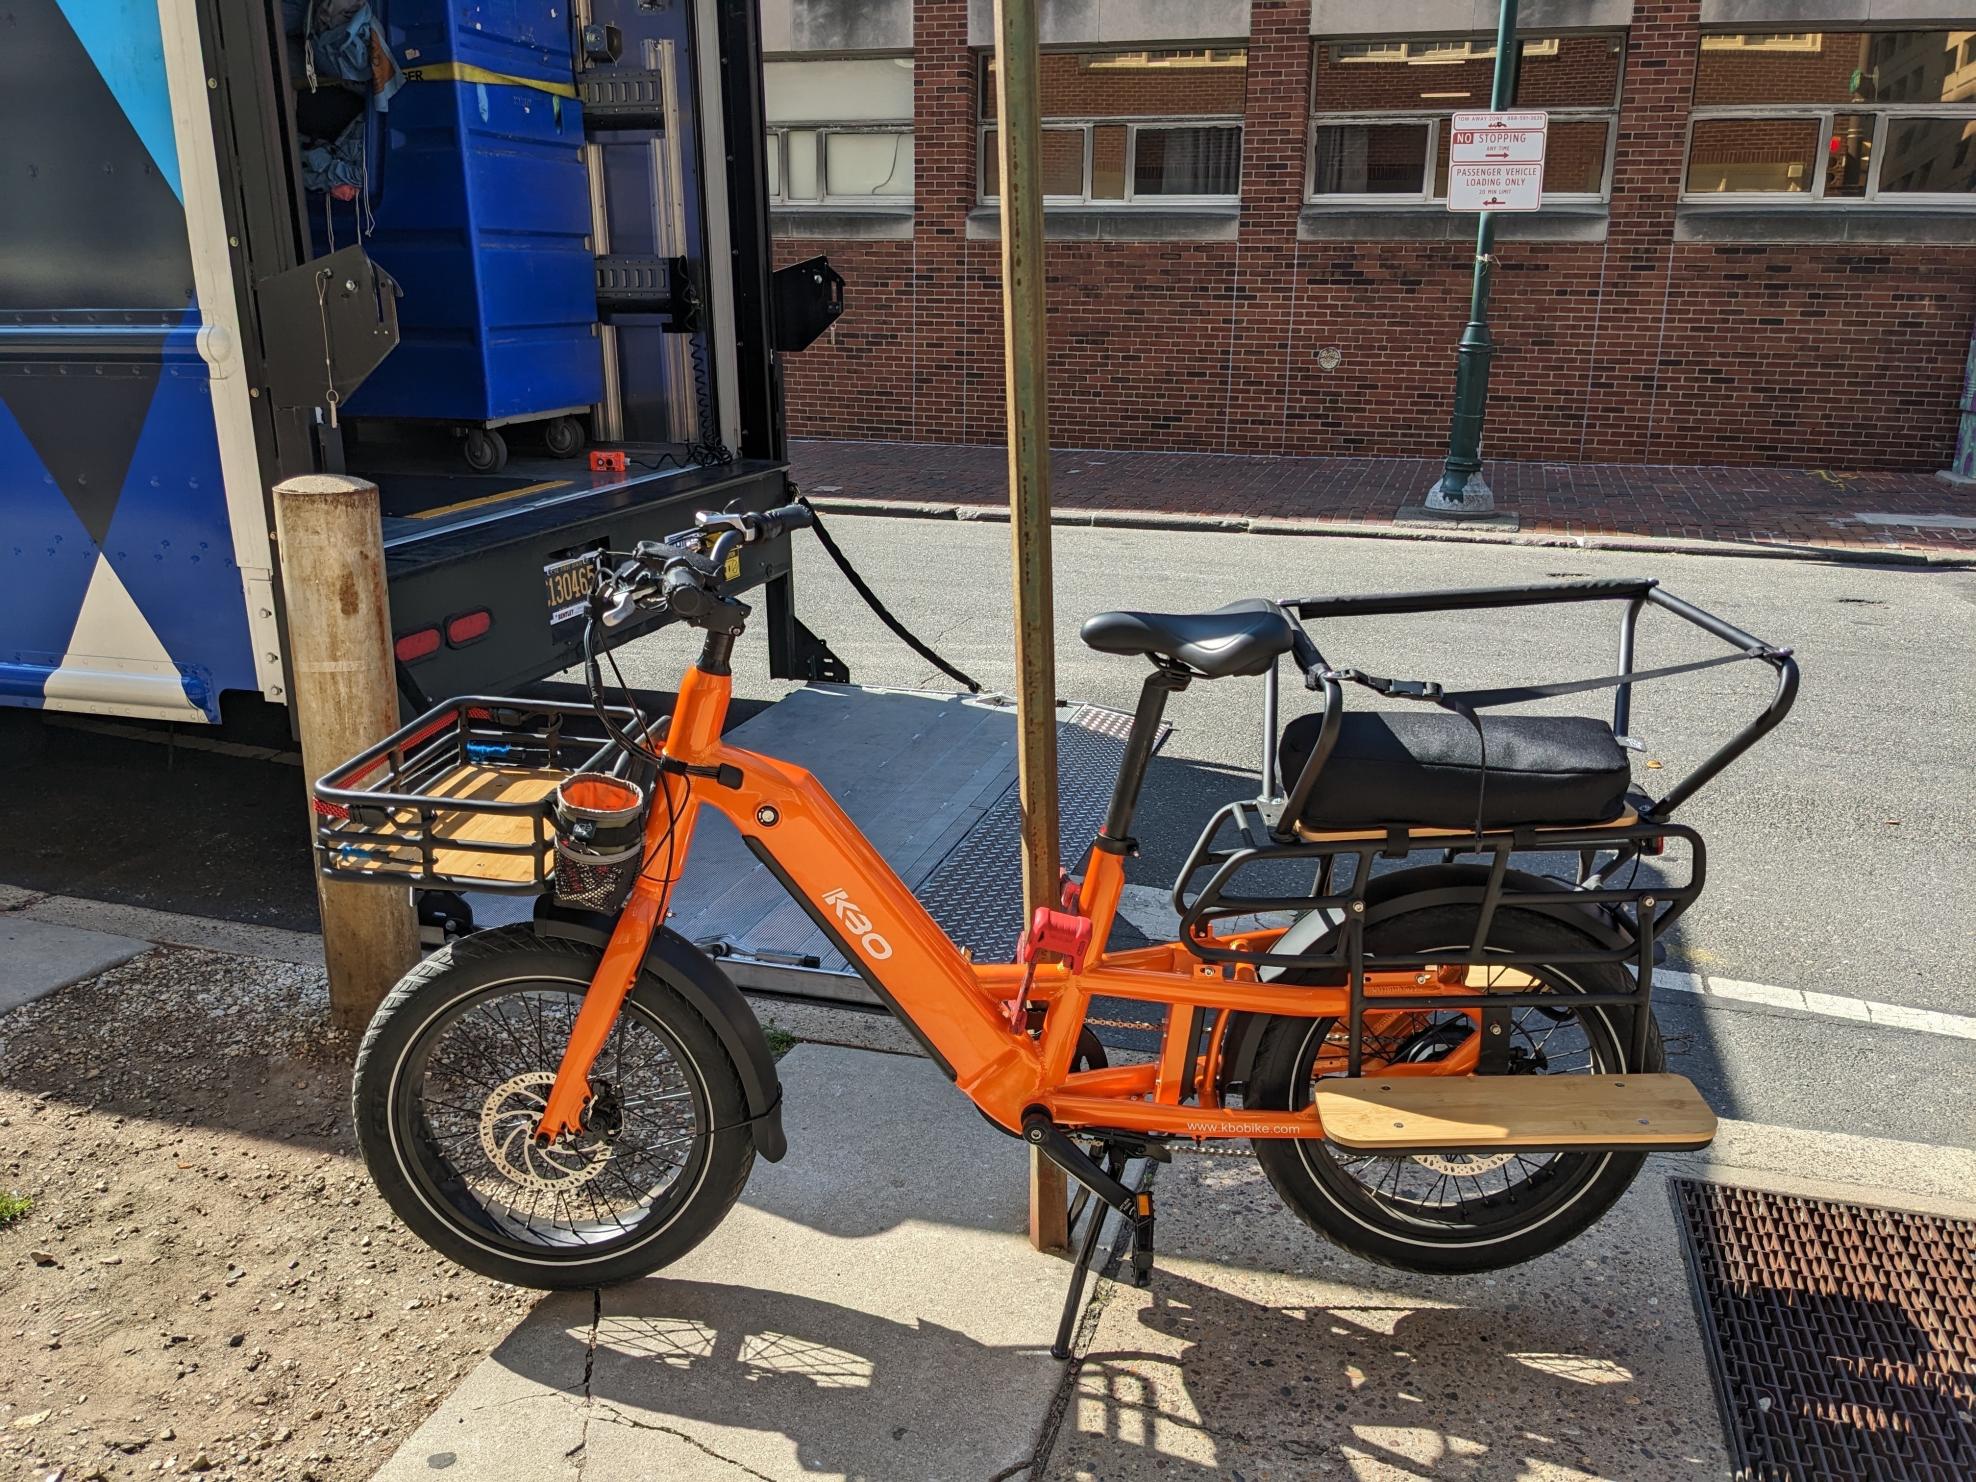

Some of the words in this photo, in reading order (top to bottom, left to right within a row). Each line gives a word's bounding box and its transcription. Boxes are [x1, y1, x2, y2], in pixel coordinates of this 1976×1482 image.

[1457, 133, 1472, 143] NO
[1478, 133, 1526, 143] STOPPING
[1456, 168, 1502, 176] PASSENGER
[1505, 167, 1537, 176] VEHICLE
[1466, 178, 1501, 187] LOADING
[1504, 178, 1526, 186] ONLY
[1187, 1121, 1300, 1134] www.kbobike.com
